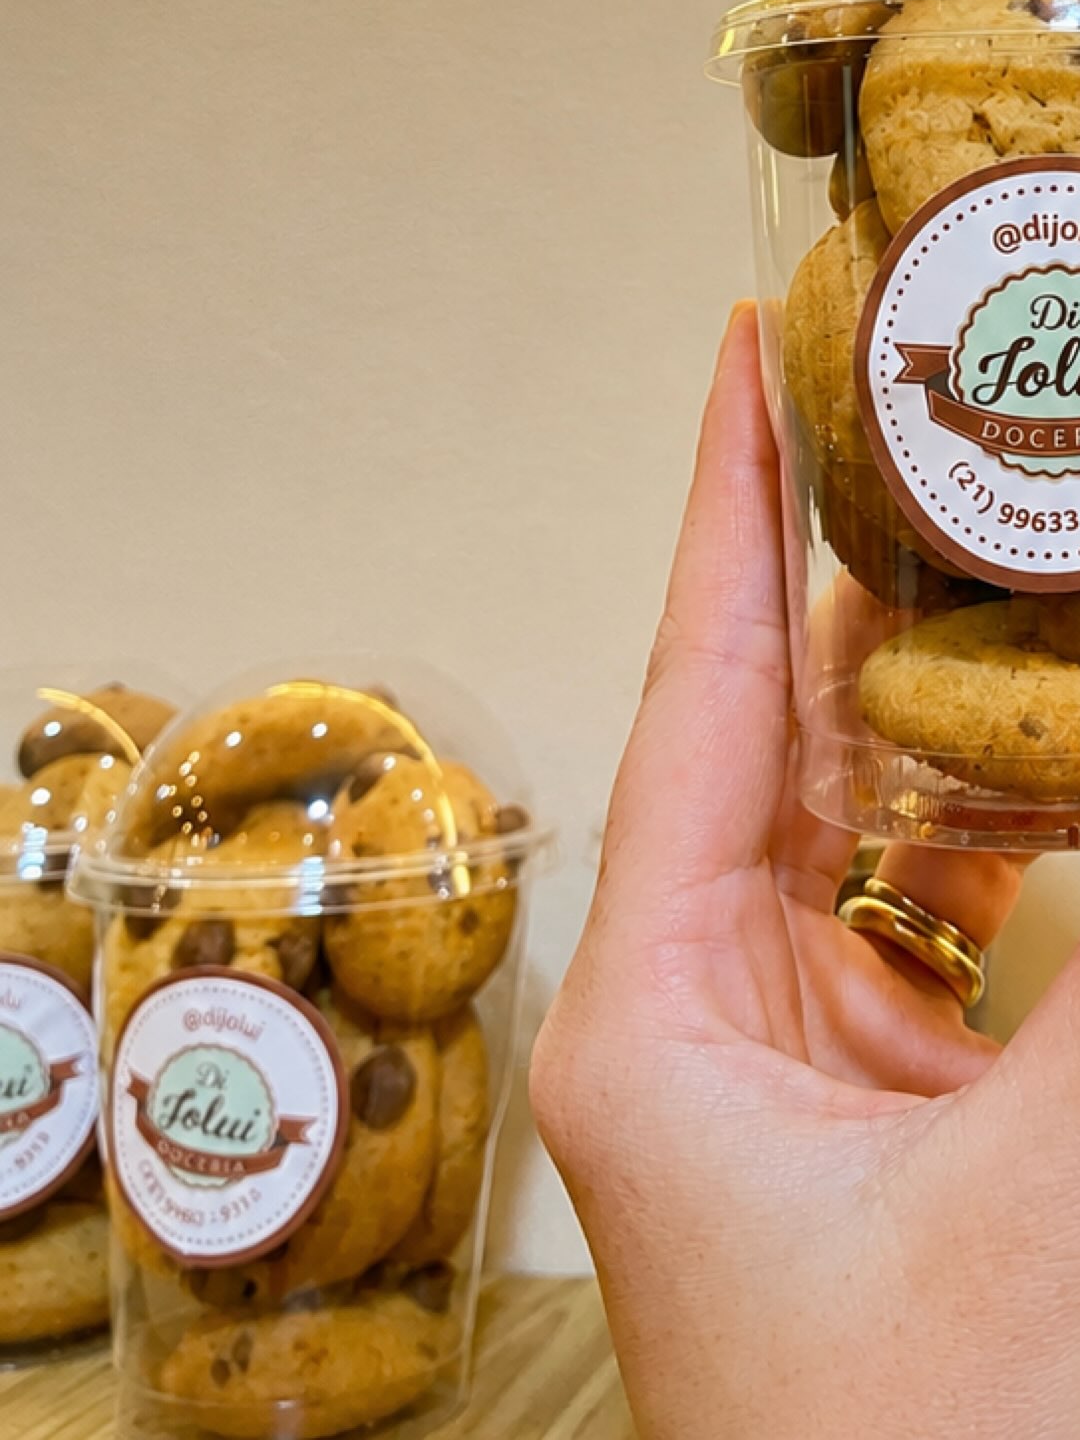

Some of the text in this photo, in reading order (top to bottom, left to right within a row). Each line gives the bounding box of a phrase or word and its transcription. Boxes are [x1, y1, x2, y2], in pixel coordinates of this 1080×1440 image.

[948, 460, 995, 515] (21)
[998, 503, 1080, 533] 99633
[194, 1062, 230, 1090] Di
[158, 1089, 262, 1144] Jolui
